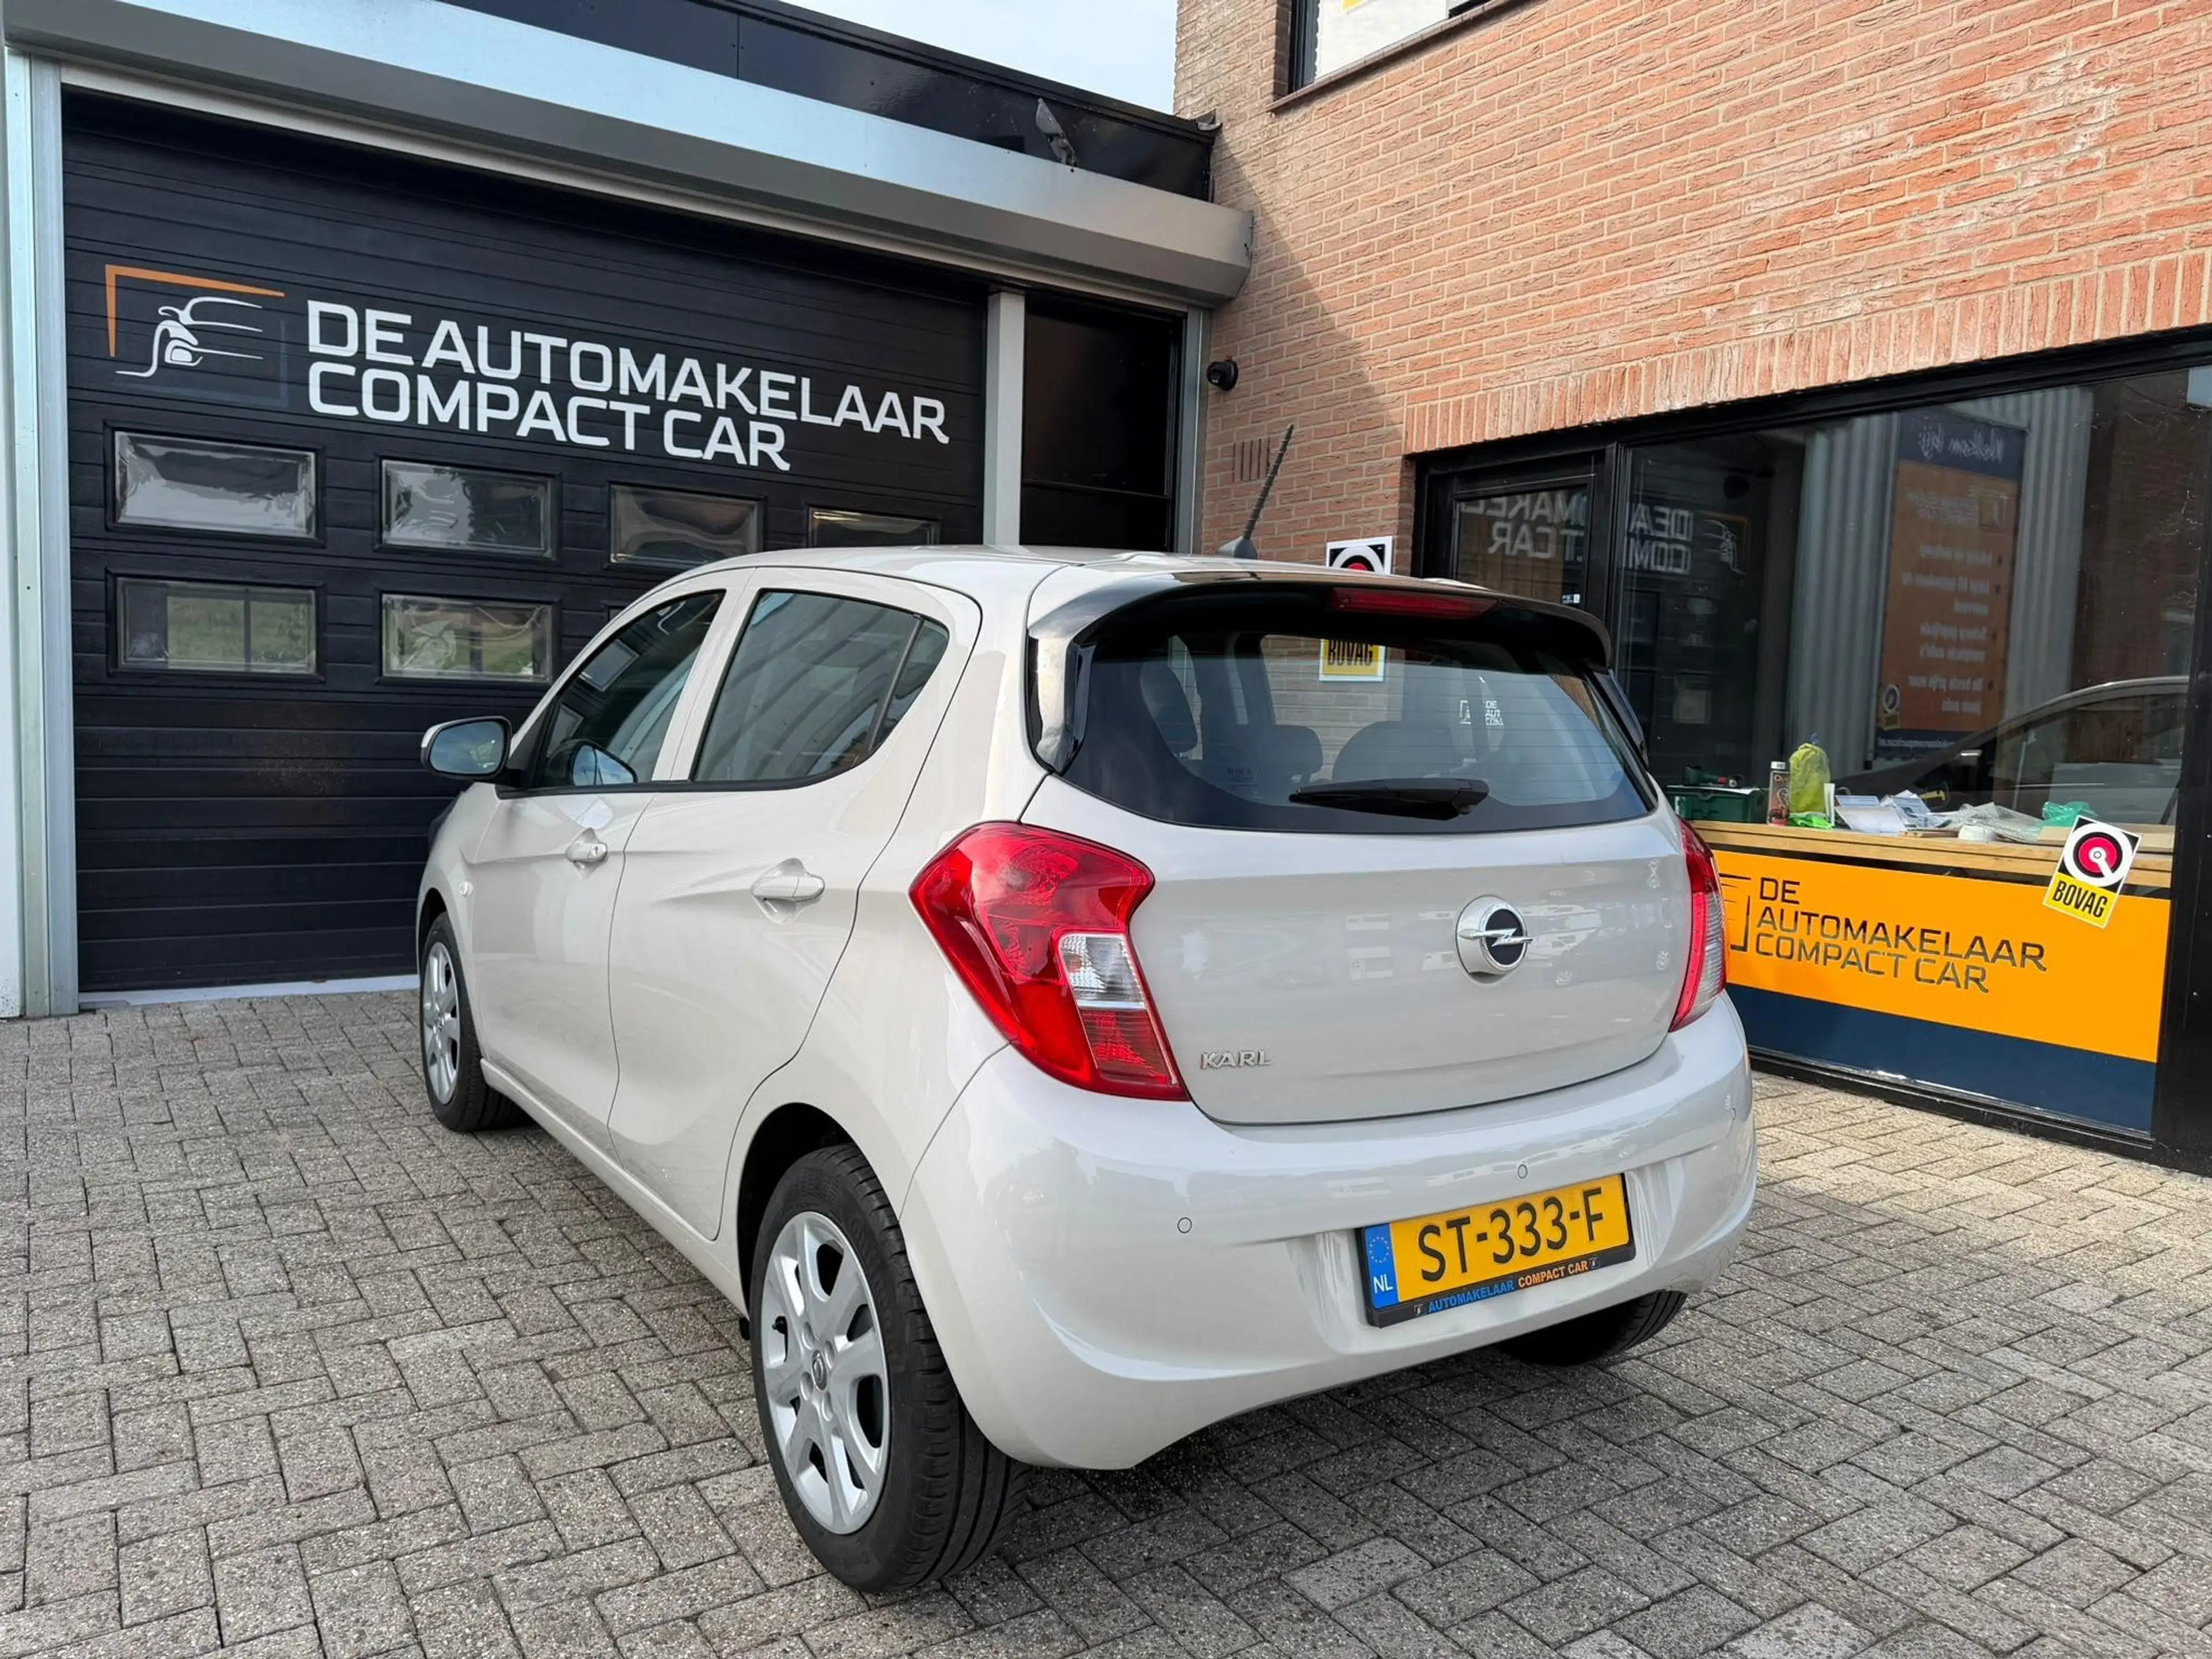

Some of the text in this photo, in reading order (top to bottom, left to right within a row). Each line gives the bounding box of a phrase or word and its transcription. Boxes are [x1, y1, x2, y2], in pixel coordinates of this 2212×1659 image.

[308, 300, 950, 444] DE AUTOMAKELAAR
[309, 361, 790, 471] COMPACT CAR
[1328, 639, 1373, 666] BOVAG
[1759, 878, 1800, 904] DE
[2052, 880, 2109, 919] BOVAG
[1755, 933, 1989, 994] COMPACT CAR
[1756, 906, 2047, 972] AUTOMAKELAAR
[1200, 1048, 1273, 1070] KARL
[1373, 1187, 1604, 1294] NL ST-333-F
[1428, 1260, 1589, 1314] AUTOMAKELAAR COMPACT CAR
